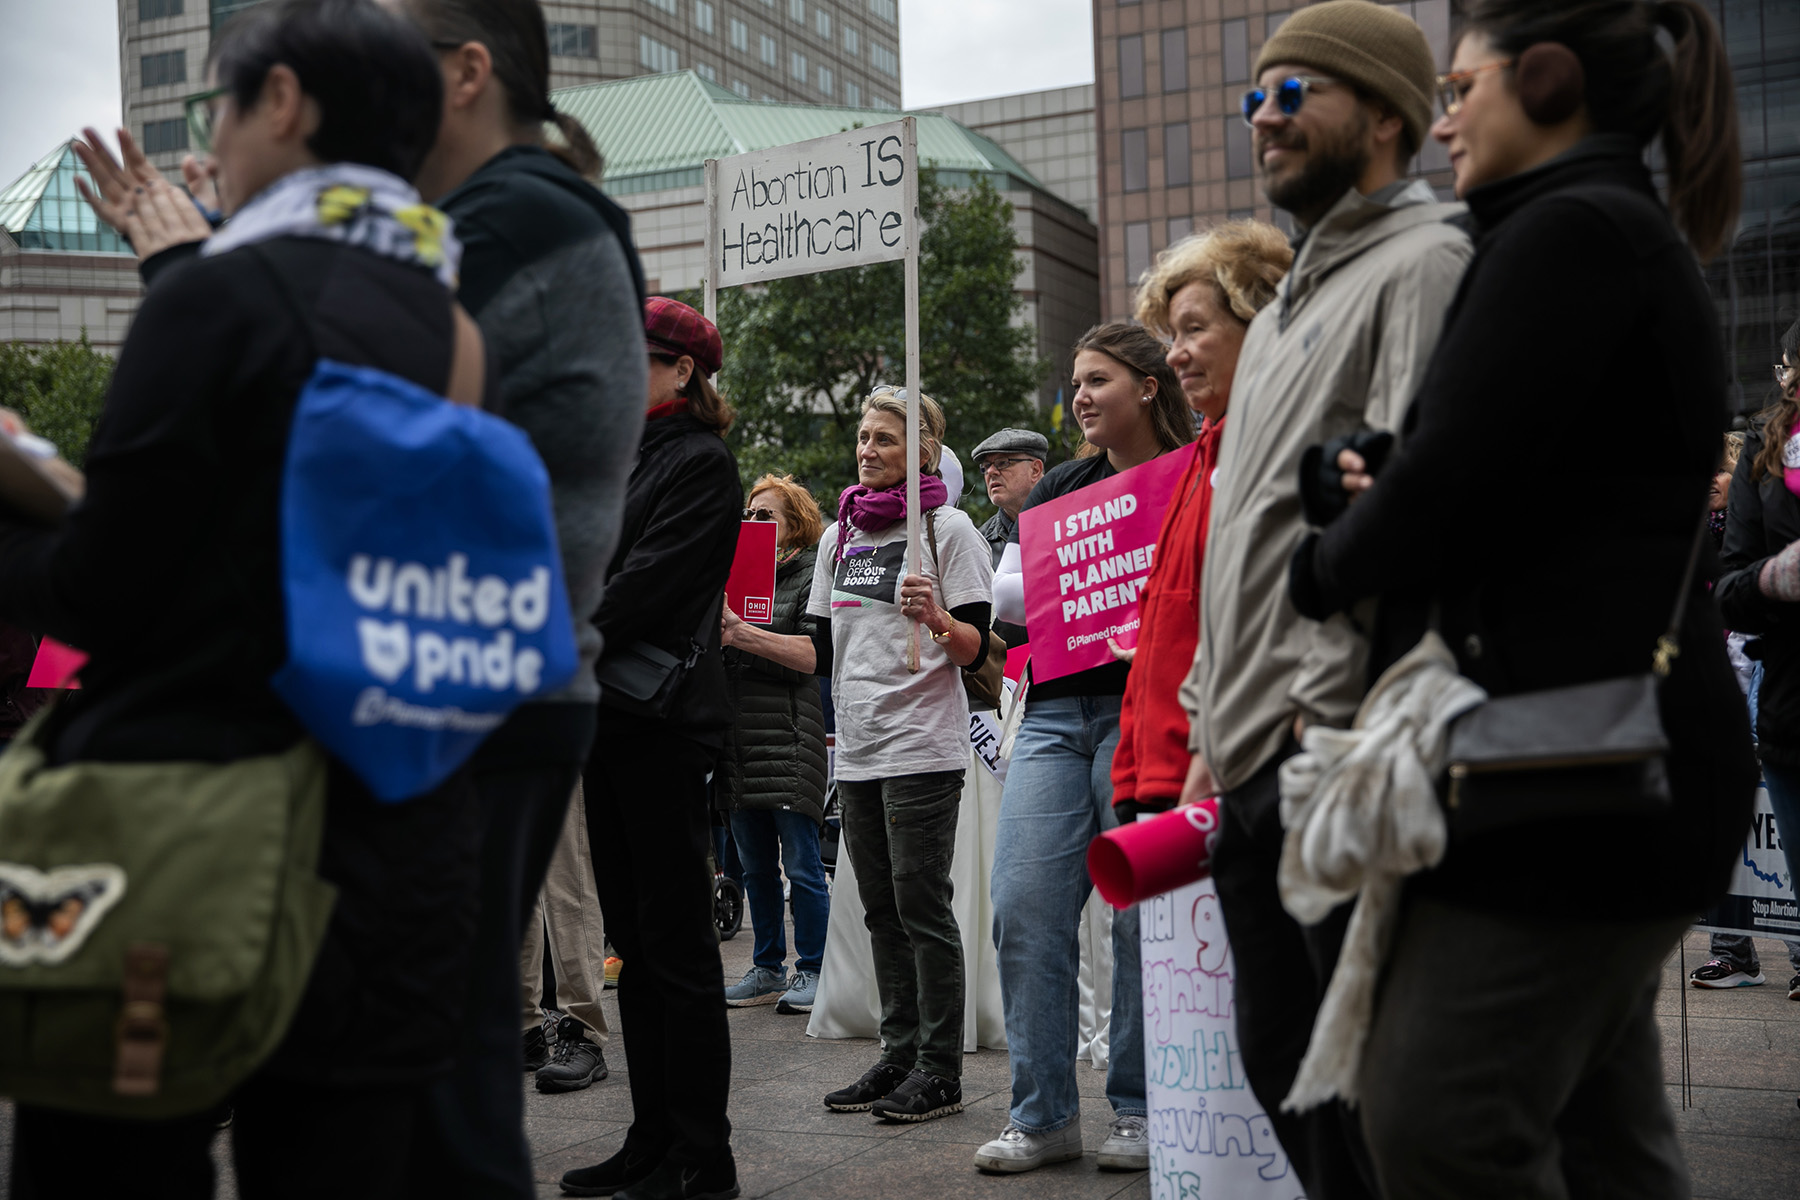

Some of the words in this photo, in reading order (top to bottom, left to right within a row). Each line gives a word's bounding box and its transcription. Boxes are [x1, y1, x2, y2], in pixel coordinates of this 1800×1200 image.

[731, 161, 847, 211] Abortion
[860, 135, 904, 188] IS
[722, 208, 902, 272] Healthcare
[1054, 521, 1061, 542] I
[1066, 494, 1137, 537] STAND
[849, 558, 873, 567] BANS
[1056, 529, 1114, 568] WITH
[348, 552, 550, 632] united
[843, 576, 880, 585] BODIES
[1076, 626, 1110, 647] Planned
[1751, 812, 1784, 851] YE
[1752, 899, 1770, 917] Stop
[1770, 901, 1798, 917] Abortion
[1150, 1091, 1289, 1181] having
